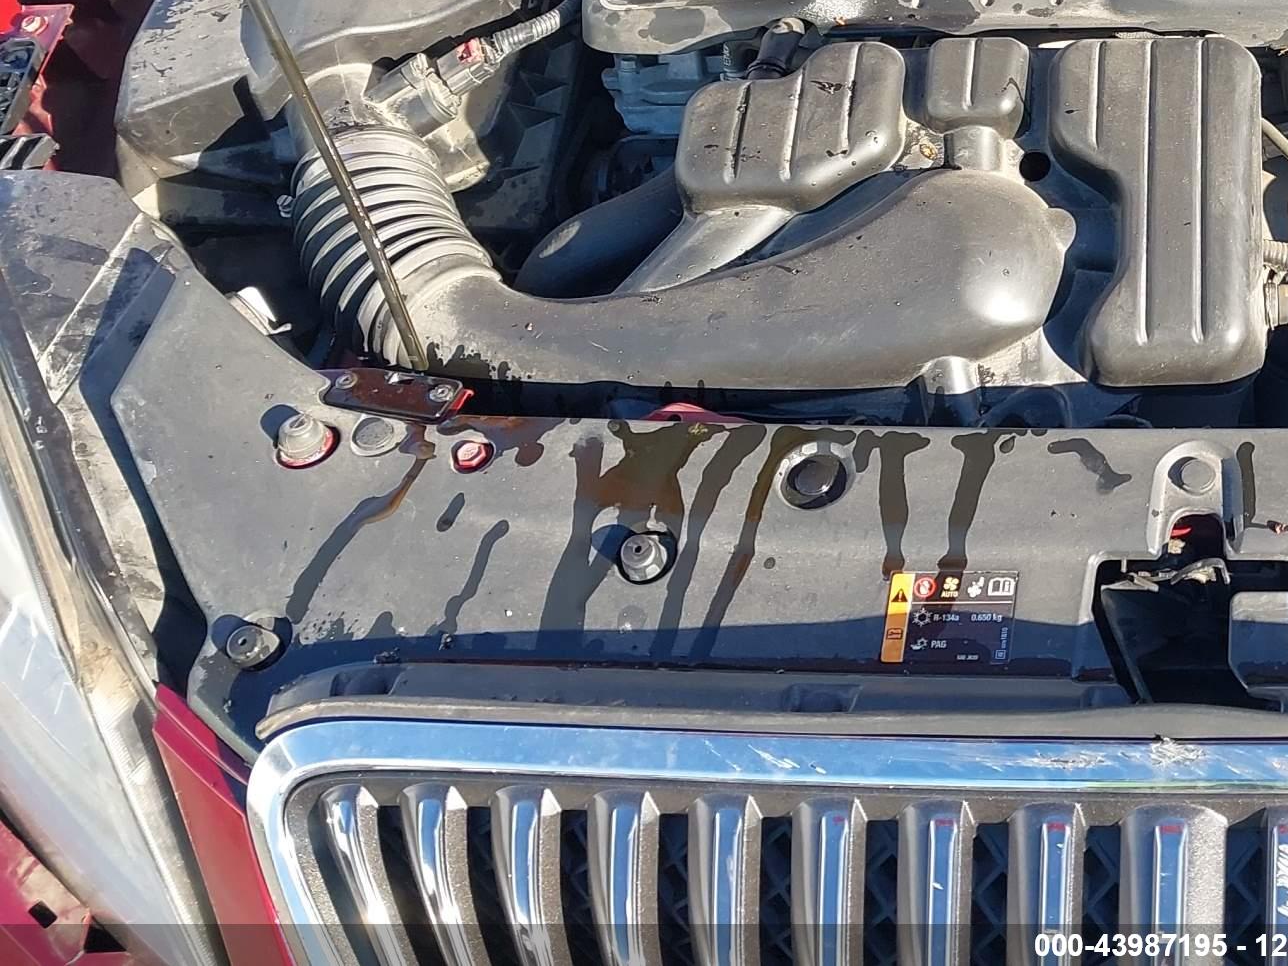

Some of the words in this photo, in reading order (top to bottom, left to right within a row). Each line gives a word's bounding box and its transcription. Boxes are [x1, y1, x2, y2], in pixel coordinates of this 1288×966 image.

[933, 613, 960, 621] R-134a
[971, 613, 991, 621] 0.650
[992, 613, 1003, 623] kg
[930, 640, 947, 649] PAG
